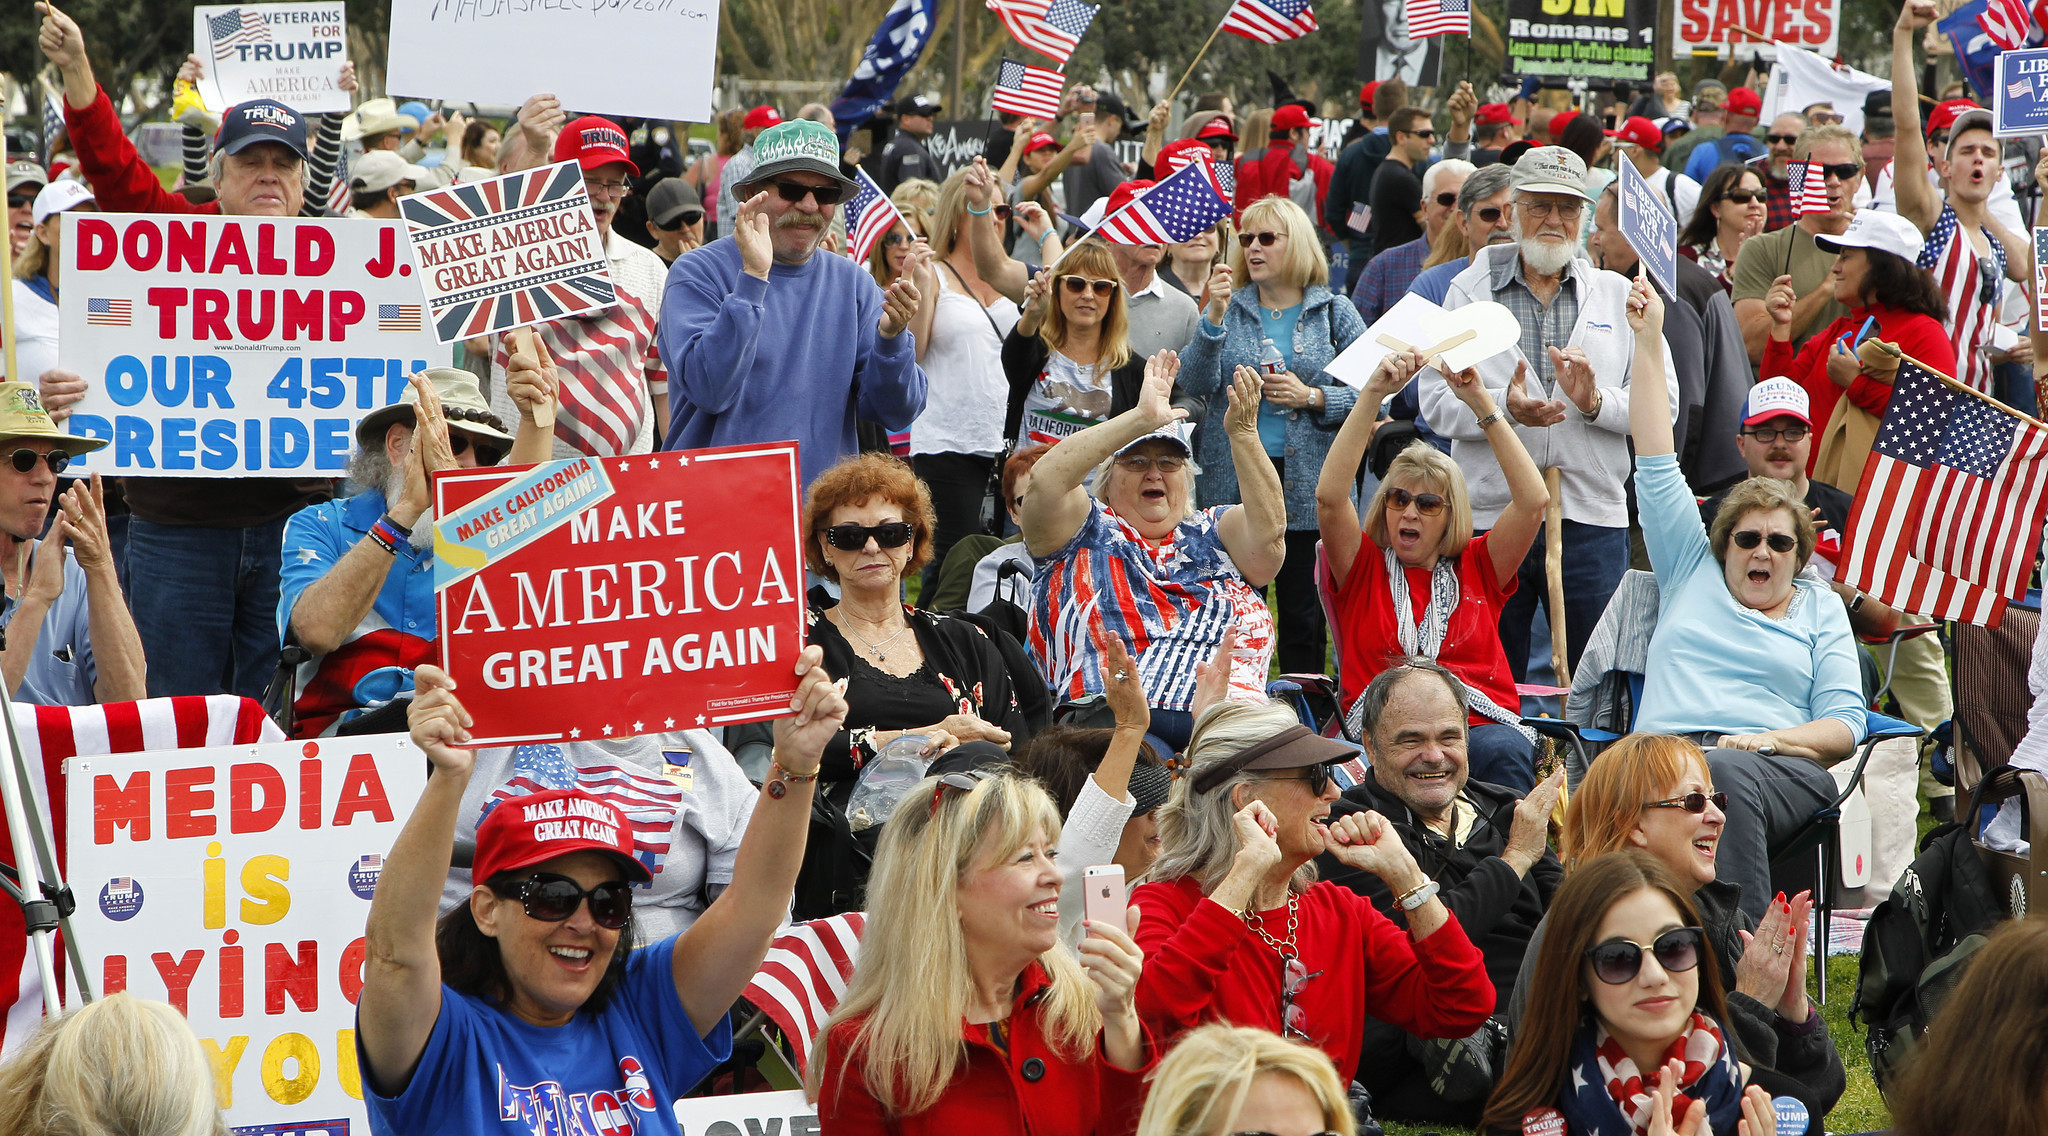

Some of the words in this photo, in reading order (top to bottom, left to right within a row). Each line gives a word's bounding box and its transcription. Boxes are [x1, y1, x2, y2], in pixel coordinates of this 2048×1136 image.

[263, 10, 340, 24] VETERANS
[312, 26, 340, 38] FOR
[1509, 18, 1630, 42] Romans
[1638, 26, 1654, 44] 1
[1681, 0, 1832, 44] SAVES
[234, 41, 342, 61] TRUMP
[246, 75, 333, 93] AMERICA
[275, 66, 300, 75] MAKE
[243, 108, 296, 126] TRUMP
[582, 131, 626, 148] TRUMP
[1628, 172, 1669, 233] LIBERTY
[1639, 200, 1659, 236] FOR
[76, 218, 336, 278] DONALD
[364, 226, 413, 279] J.
[418, 233, 487, 269] MAKE
[490, 209, 594, 253] AMERICA
[1640, 219, 1658, 250] ALL
[434, 254, 508, 293] GREAT
[514, 236, 592, 276] AGAIN!
[147, 287, 366, 342] TRUMP
[214, 344, 302, 352] www.DonaldJTrump.com
[104, 354, 236, 410] OUR
[266, 357, 428, 410] 45TH
[1758, 382, 1804, 394] TRUMP
[68, 414, 362, 472] PRESIDE
[455, 507, 505, 542] MAKE
[505, 458, 592, 515] CALIFORNIA
[485, 507, 540, 549] GREAT
[542, 470, 599, 520] AGAIN!
[570, 500, 686, 545] MAKE
[452, 546, 795, 635] AMERICA
[482, 641, 630, 691] GREAT
[641, 624, 777, 678] AGAIN
[522, 799, 566, 822] MAKE
[566, 798, 620, 828] AMERICA
[534, 820, 582, 842] GREAT
[582, 821, 619, 848] AGAIN
[103, 892, 140, 902] TRUMP
[1526, 1111, 1558, 1124] Dald
[1526, 1118, 1565, 1134] TRUMP
[1776, 1112, 1809, 1122] RUMP
